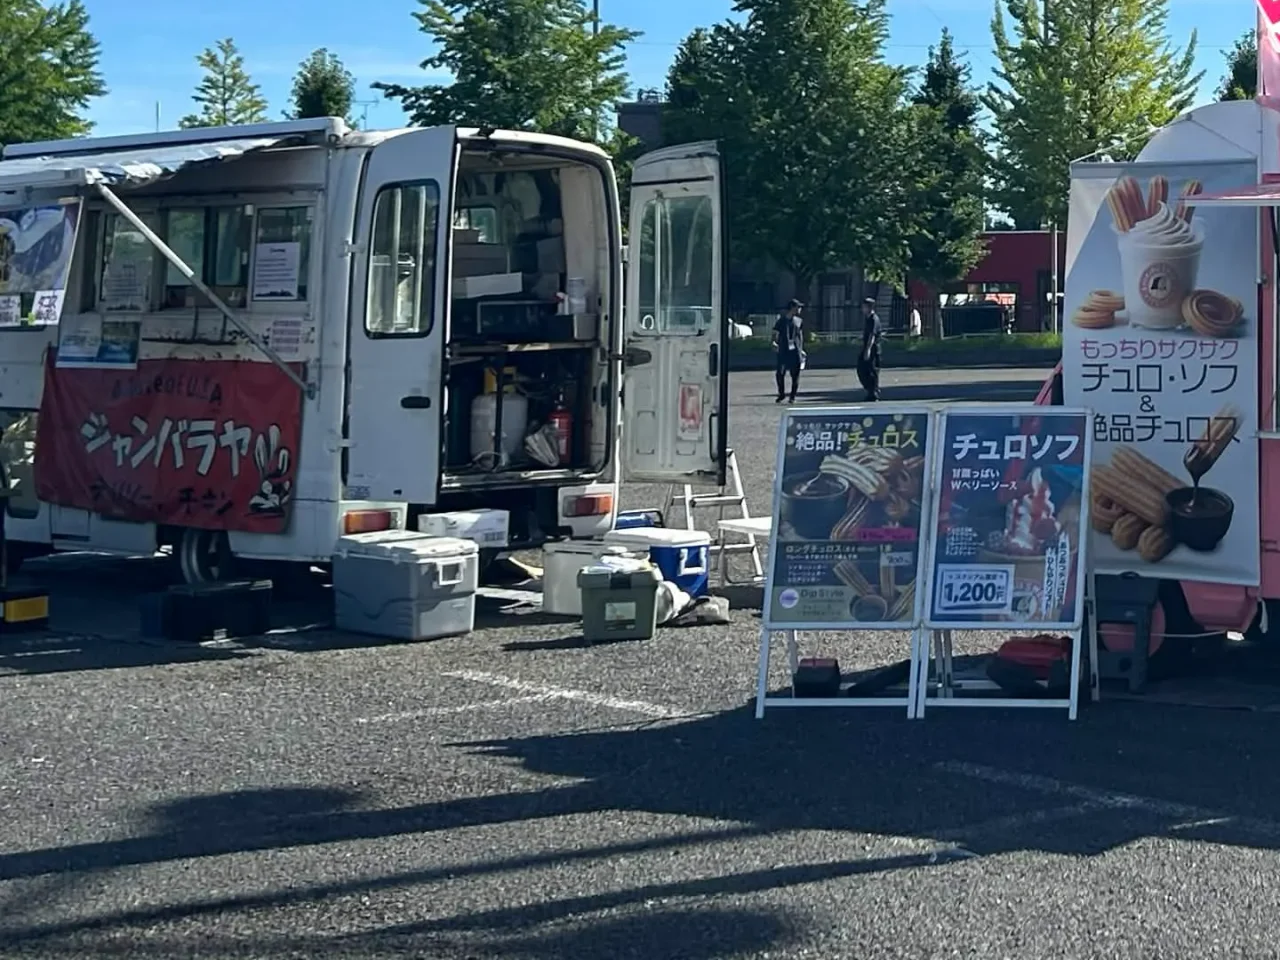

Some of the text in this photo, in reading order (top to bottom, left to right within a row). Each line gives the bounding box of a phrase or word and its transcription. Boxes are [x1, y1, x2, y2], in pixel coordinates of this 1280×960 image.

[1081, 339, 1239, 360] もっちりサクサク
[1081, 363, 1239, 393] チュロ・ソフ
[1139, 395, 1156, 413] &
[80, 412, 252, 478] ジャンバラヤ
[953, 433, 1080, 461] チュロソフ
[951, 480, 1018, 490] Wベリーソース
